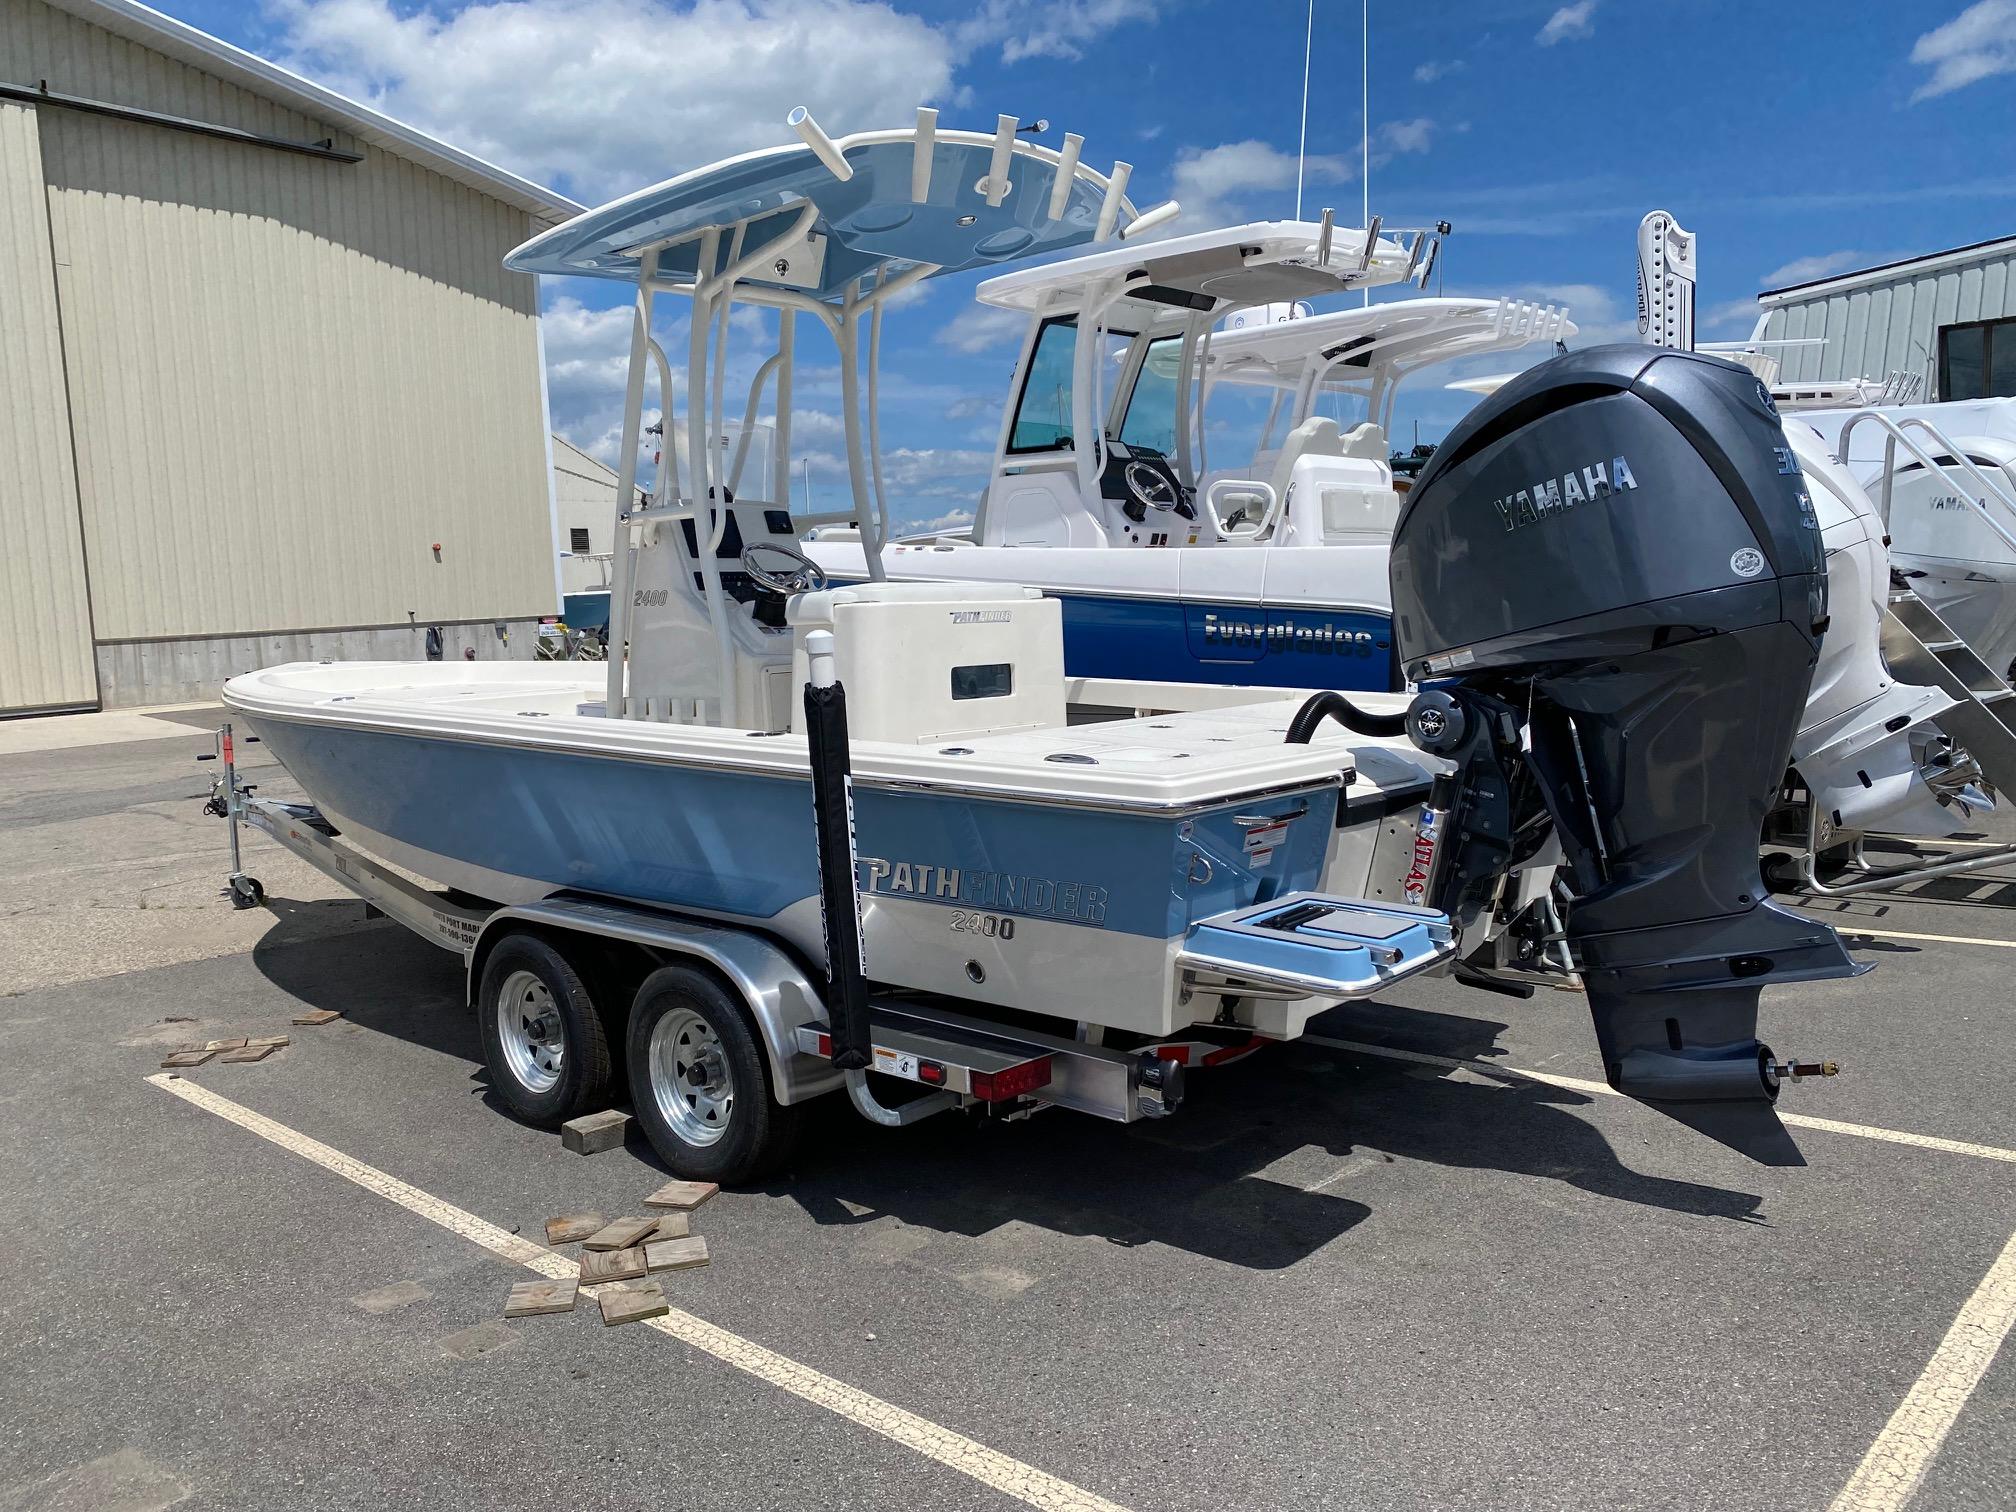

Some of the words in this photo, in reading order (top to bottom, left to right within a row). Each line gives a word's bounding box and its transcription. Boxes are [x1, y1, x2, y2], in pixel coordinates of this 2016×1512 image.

[1494, 455, 1638, 532] YAMAHA
[1929, 495, 1986, 511] YAMAA
[633, 589, 668, 607] 2400
[950, 610, 1012, 624] PATHFINDER
[1205, 614, 1373, 656] Everglades
[1405, 834, 1434, 893] ATLAS
[858, 856, 1109, 925] PATHFINDER
[951, 909, 1015, 940] 2400
